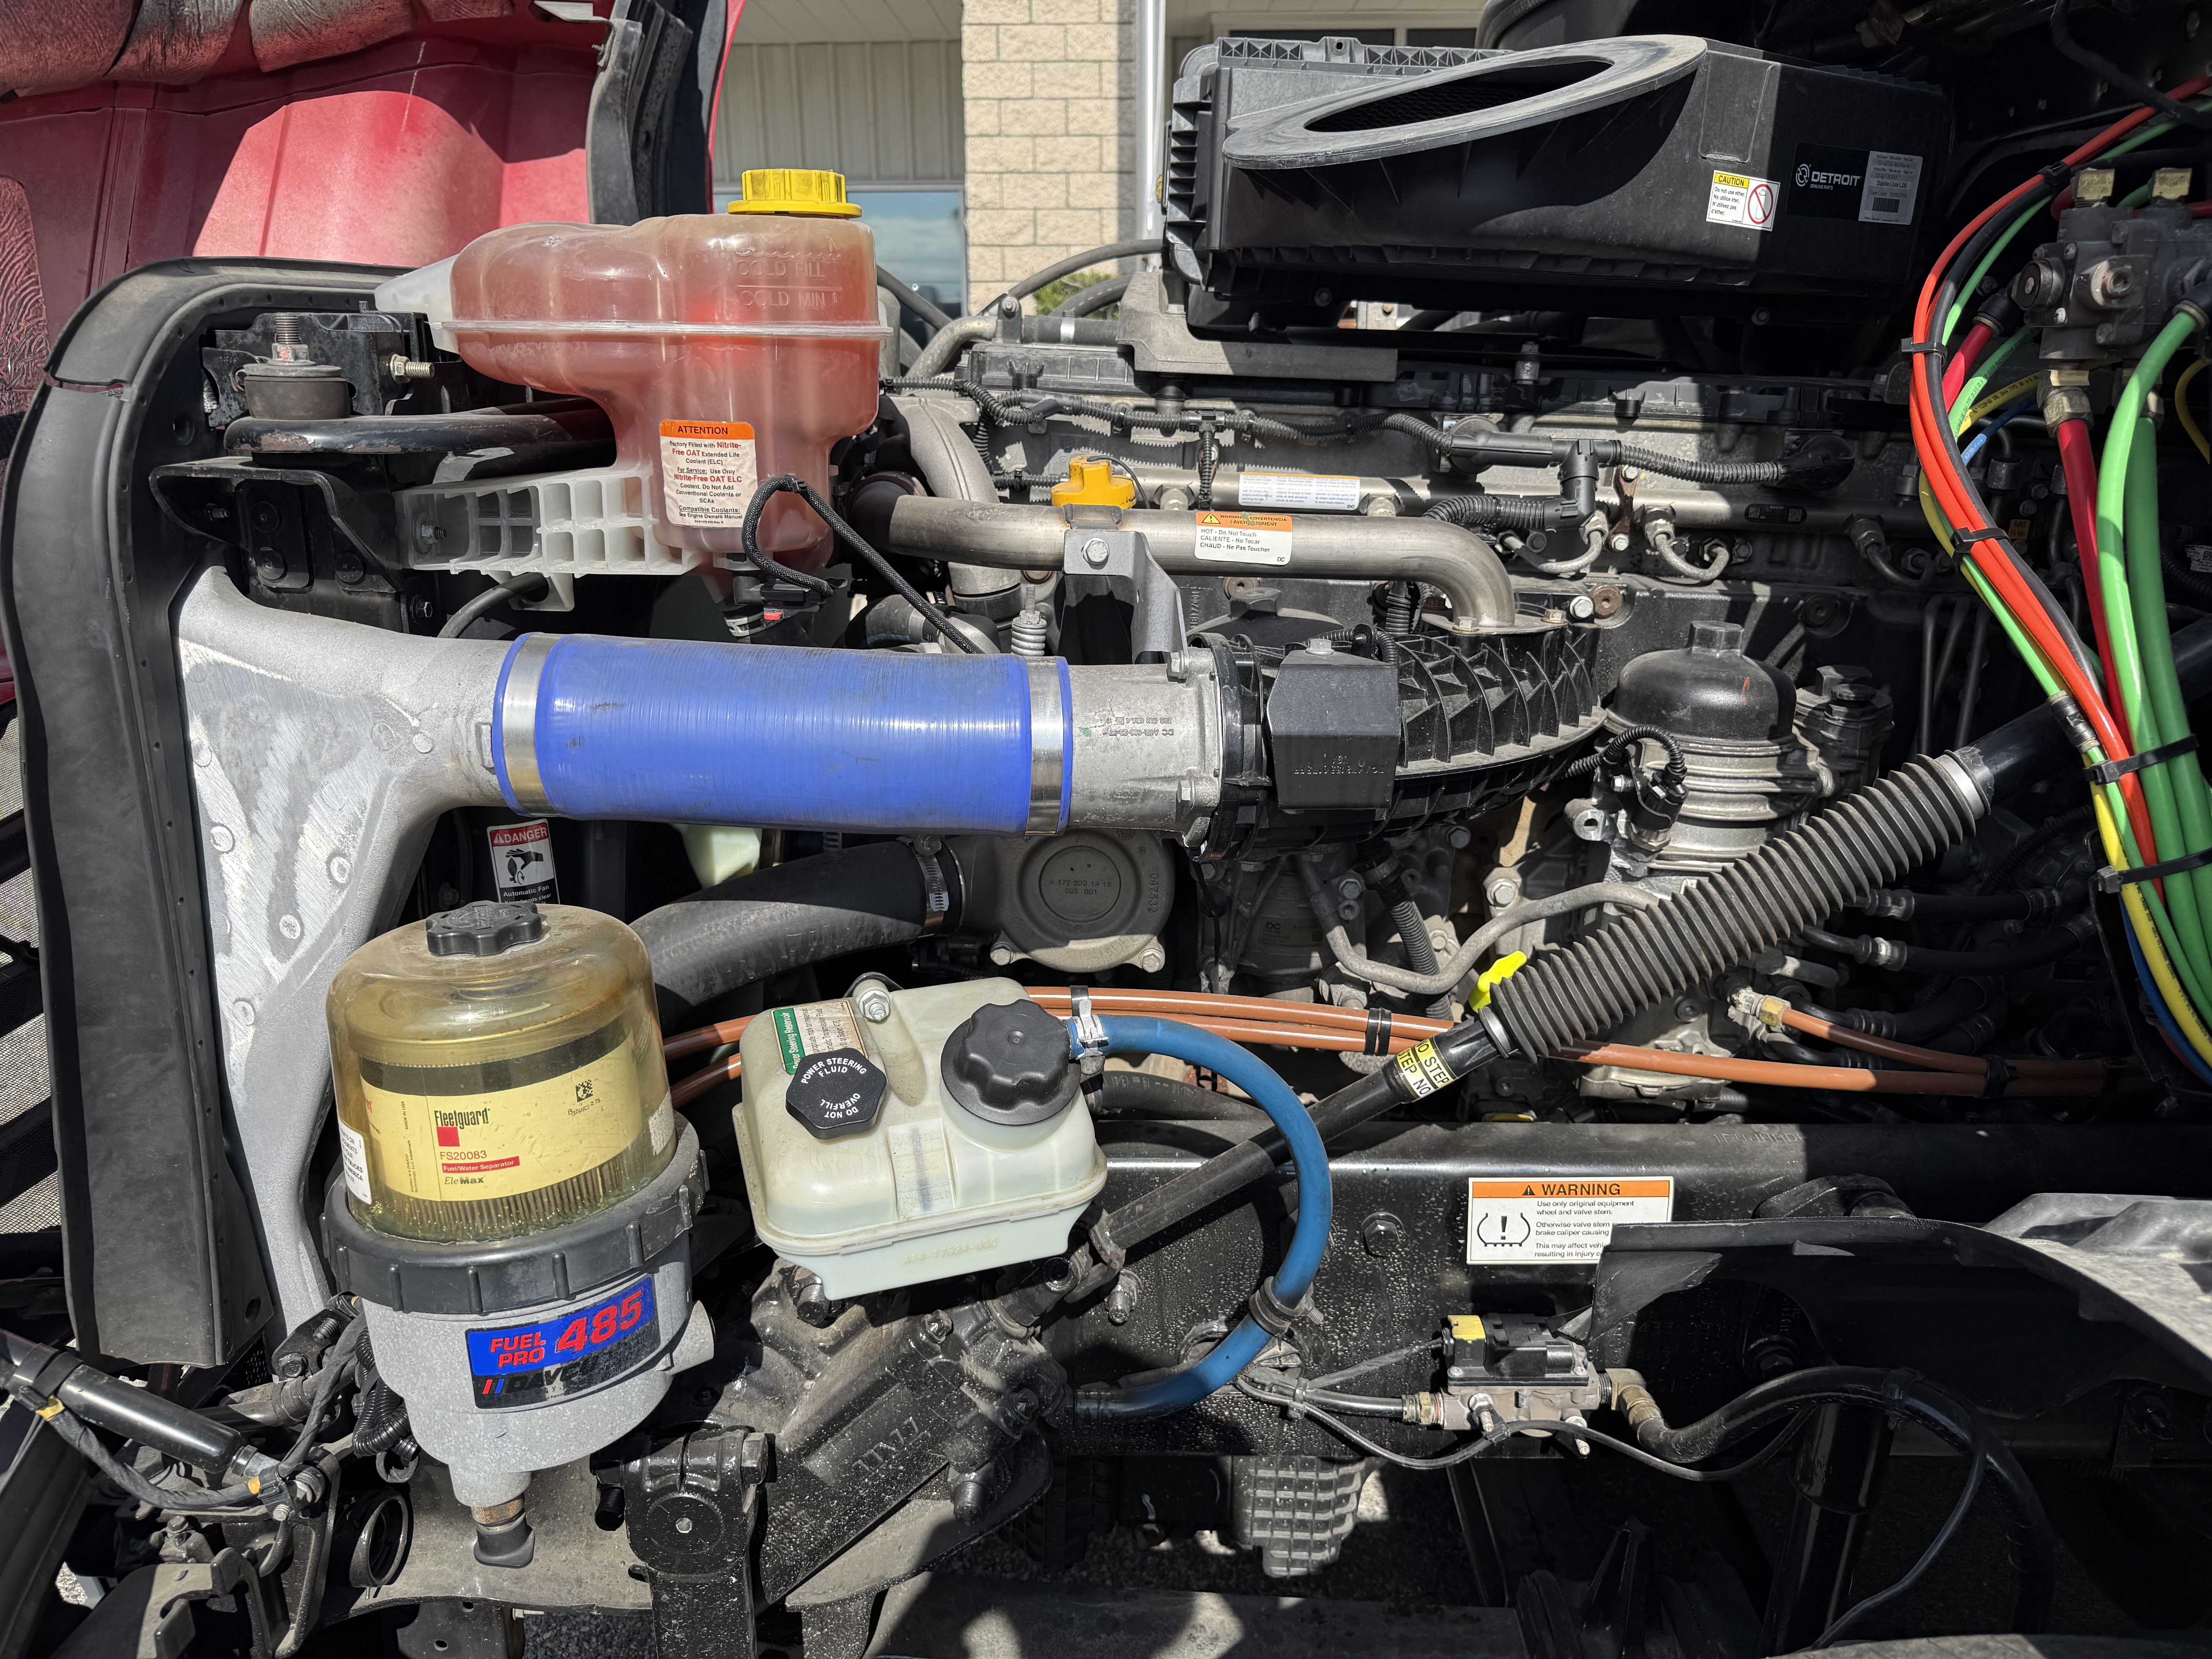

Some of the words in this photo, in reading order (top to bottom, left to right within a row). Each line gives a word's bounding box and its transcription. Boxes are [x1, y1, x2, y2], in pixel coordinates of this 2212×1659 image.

[1719, 175, 1745, 186] CAUTION
[1811, 171, 1860, 186] DETROIT
[737, 259, 787, 278] COLD
[795, 262, 826, 280] FILL
[740, 290, 790, 308] COLD
[799, 292, 826, 309] MIN
[678, 426, 728, 434] ATTENTION
[674, 474, 708, 482] Nitrite-Free
[504, 827, 547, 843] DANGER
[503, 888, 536, 896] Automatic
[1266, 922, 1281, 930] DC
[781, 1012, 794, 1033] Reservoir
[818, 1017, 831, 1039] Transmission
[786, 1033, 798, 1053] Steering
[801, 1060, 825, 1084] POWER
[826, 1057, 867, 1075] STEERING
[818, 1066, 848, 1077] FLUID
[1398, 1049, 1417, 1073] STEP
[1413, 1079, 1431, 1094] NO
[1424, 1056, 1449, 1084] STEP
[819, 1093, 861, 1111] OVERFILL
[434, 1108, 489, 1130] Fleetguard
[824, 1110, 843, 1119] NOT
[846, 1106, 859, 1116] DO
[440, 1150, 487, 1160] FS20083
[480, 1160, 514, 1170] Separator
[1541, 1183, 1621, 1196] WARNING
[901, 1237, 998, 1266] A14-17924-000
[1534, 1250, 1565, 1259] resulting
[1575, 1250, 1595, 1259] injury
[555, 1289, 643, 1353] 485
[490, 1331, 546, 1353] FUEL
[498, 1348, 545, 1368] PRO
